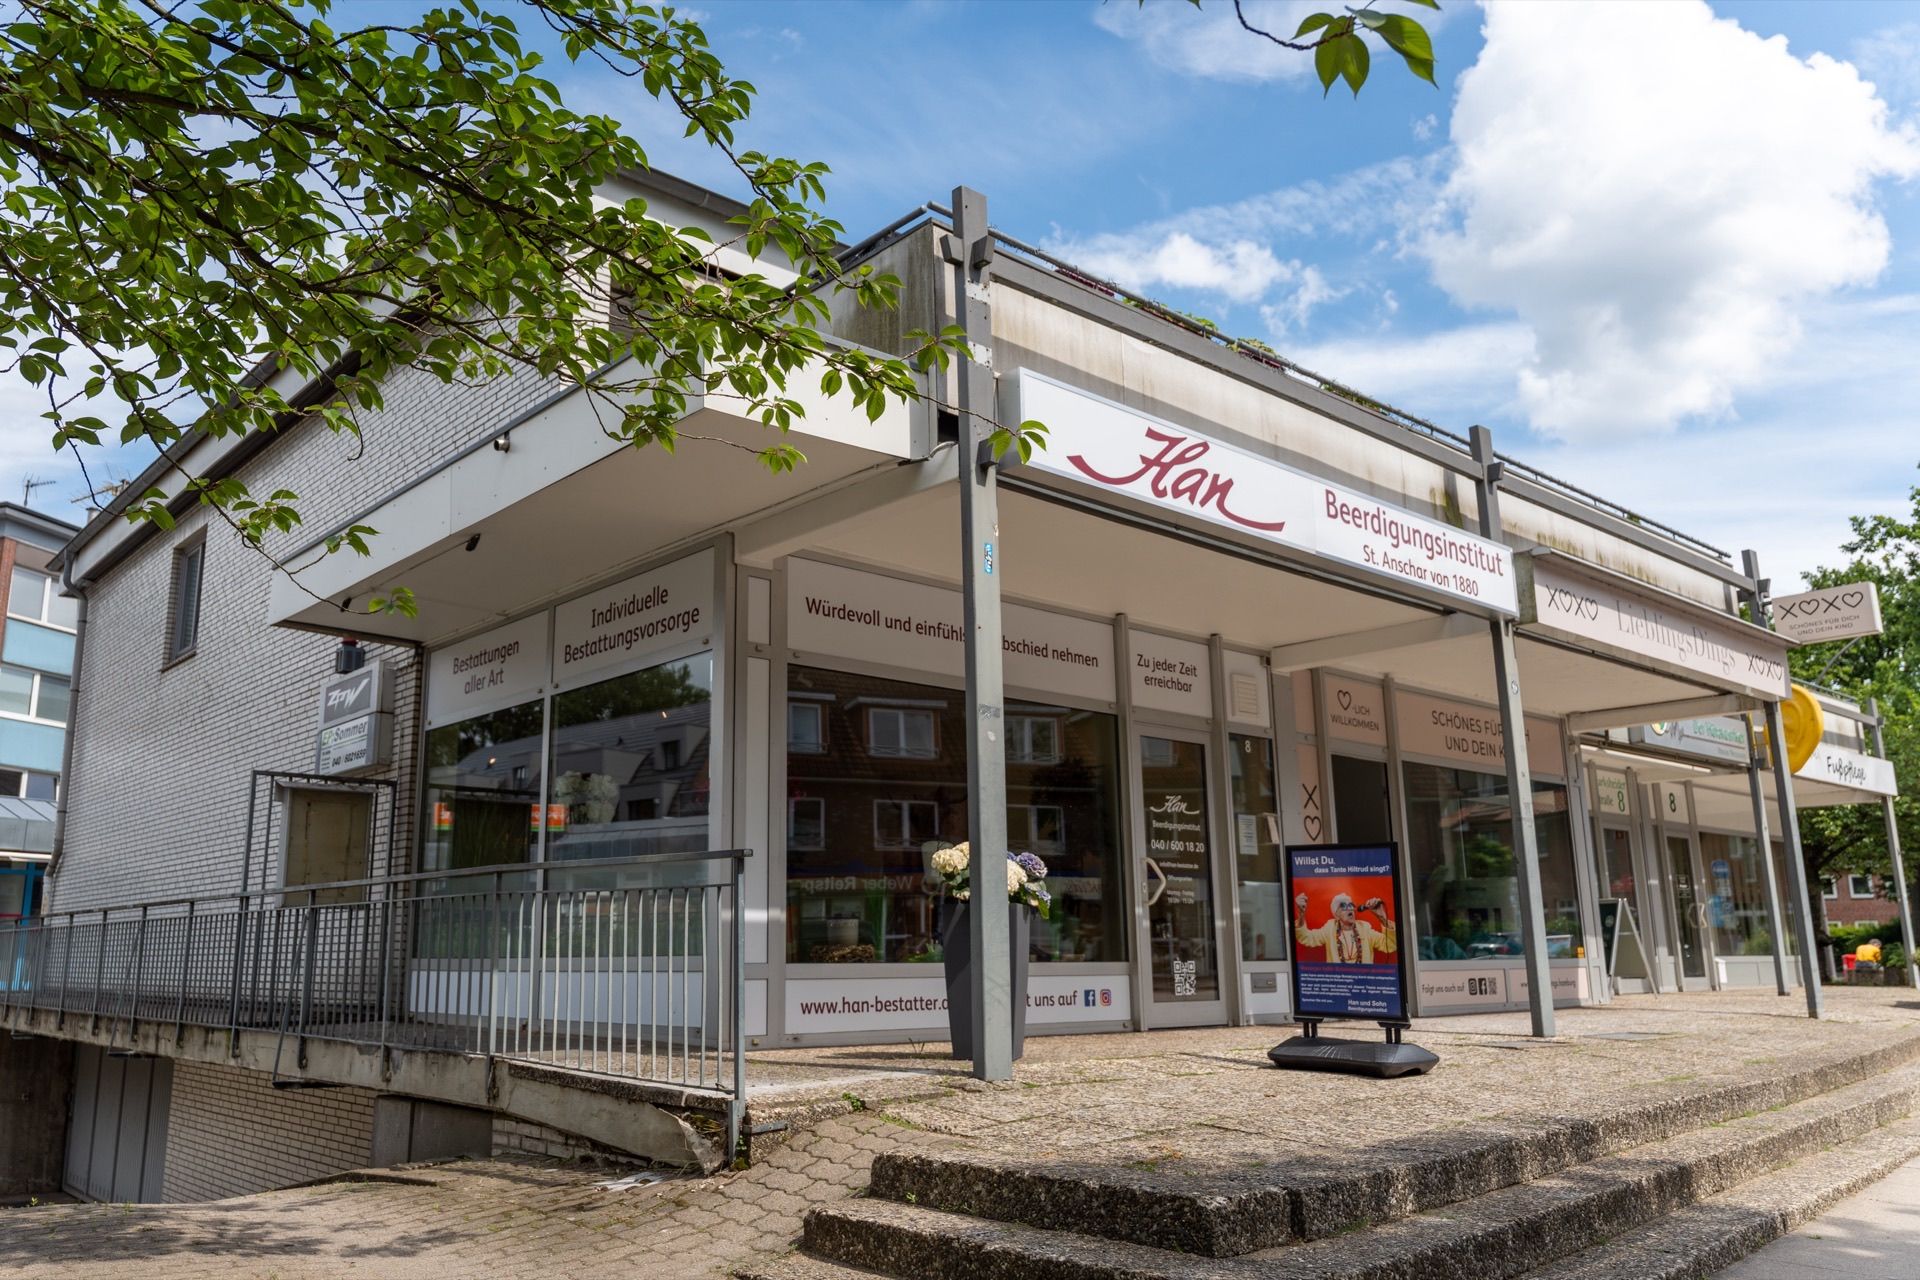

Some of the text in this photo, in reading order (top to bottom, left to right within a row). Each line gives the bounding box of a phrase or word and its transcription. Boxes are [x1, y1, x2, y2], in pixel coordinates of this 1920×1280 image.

[1067, 426, 1286, 532] Han
[1325, 489, 1505, 578] Beerdigungsinstitut
[1363, 545, 1480, 598] St. Anschar von 1880
[591, 585, 669, 628] Individuelle
[805, 597, 880, 627] Würdevoll
[884, 615, 911, 634] und
[1001, 634, 1049, 659] bschied
[1052, 645, 1099, 668] nehmen
[1789, 614, 1860, 630] SCHÖNES FÜR DICH
[1797, 622, 1854, 636] UND DEIN KIND
[564, 607, 700, 664] Bestattungsvorsorge
[453, 638, 520, 675] Bestattungen
[1137, 653, 1198, 678] Zu jeder Zeit
[464, 668, 505, 695] aller Art
[1144, 672, 1193, 693] erreichbar
[1331, 713, 1379, 732] WILLKOMMEN
[1431, 709, 1482, 734] SCHÖNES
[1244, 740, 1252, 754] 8
[1445, 735, 1469, 753] UND
[1472, 740, 1497, 758] DEIN
[1150, 795, 1200, 815] Han
[1617, 790, 1625, 812] 8
[1668, 792, 1677, 812] 8
[1152, 819, 1201, 833] Beerdigungsinstitut
[1151, 839, 1165, 851] 040
[1170, 840, 1185, 852] 600
[1186, 841, 1195, 853] 18
[1195, 842, 1205, 853] 20
[1294, 856, 1319, 866] Willst
[1314, 866, 1329, 874] dass
[1347, 865, 1369, 873] Hiltrud
[1369, 864, 1390, 874] singt?
[800, 995, 950, 1016] www.han-bestatter.d
[1034, 994, 1055, 1007] uns
[1058, 990, 1077, 1007] auf
